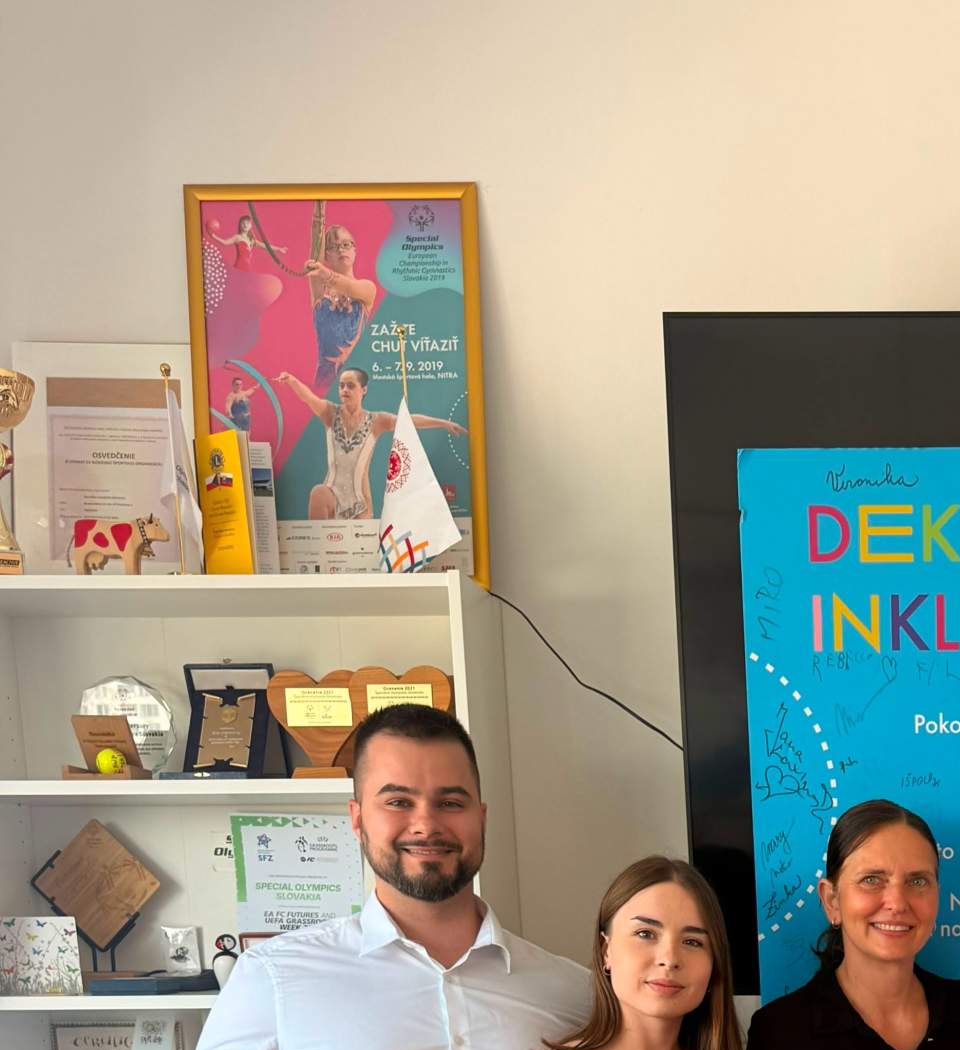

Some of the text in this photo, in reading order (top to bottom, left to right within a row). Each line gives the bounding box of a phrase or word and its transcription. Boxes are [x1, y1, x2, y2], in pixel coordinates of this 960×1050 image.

[370, 320, 416, 336] ZAŽTE
[372, 361, 382, 372] 6.
[417, 361, 443, 371] 2019
[255, 882, 342, 892] SPECIAL OLYMPICS
[276, 893, 322, 901] SLOVAKIA
